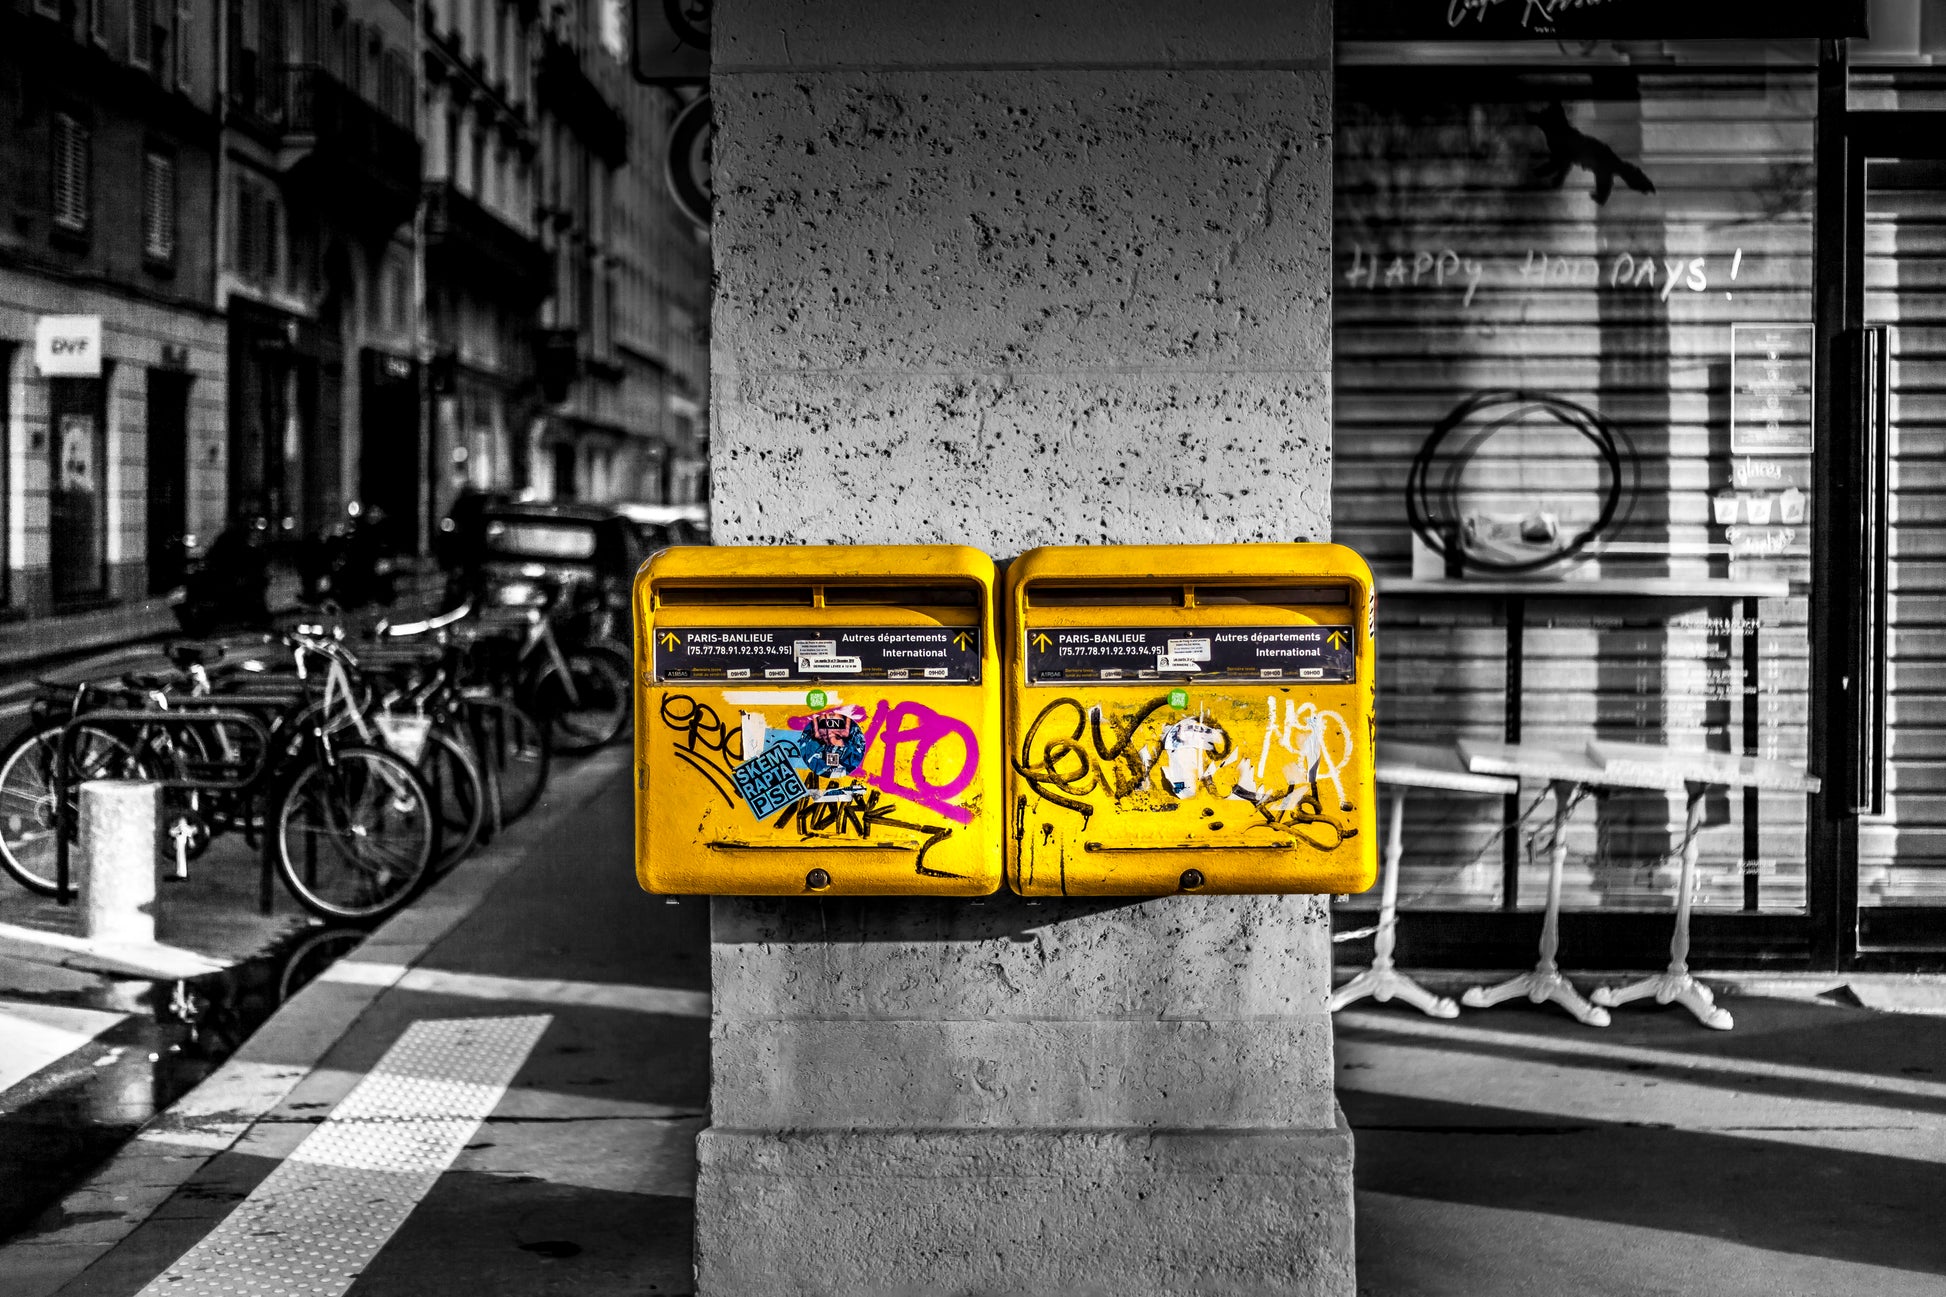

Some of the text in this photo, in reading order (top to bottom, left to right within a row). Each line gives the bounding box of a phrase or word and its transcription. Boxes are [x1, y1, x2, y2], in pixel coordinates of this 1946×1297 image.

[687, 633, 773, 643] PARIS-BANLIEUE
[842, 632, 947, 644] Autres départements
[1059, 634, 1146, 643] PARIS-BANLIEUE
[1215, 632, 1321, 644] Autres départements
[883, 648, 947, 657] International
[1256, 647, 1321, 657] International
[736, 748, 785, 784] SKEM
[742, 763, 793, 799] RAPTA
[753, 779, 800, 815] PSG
